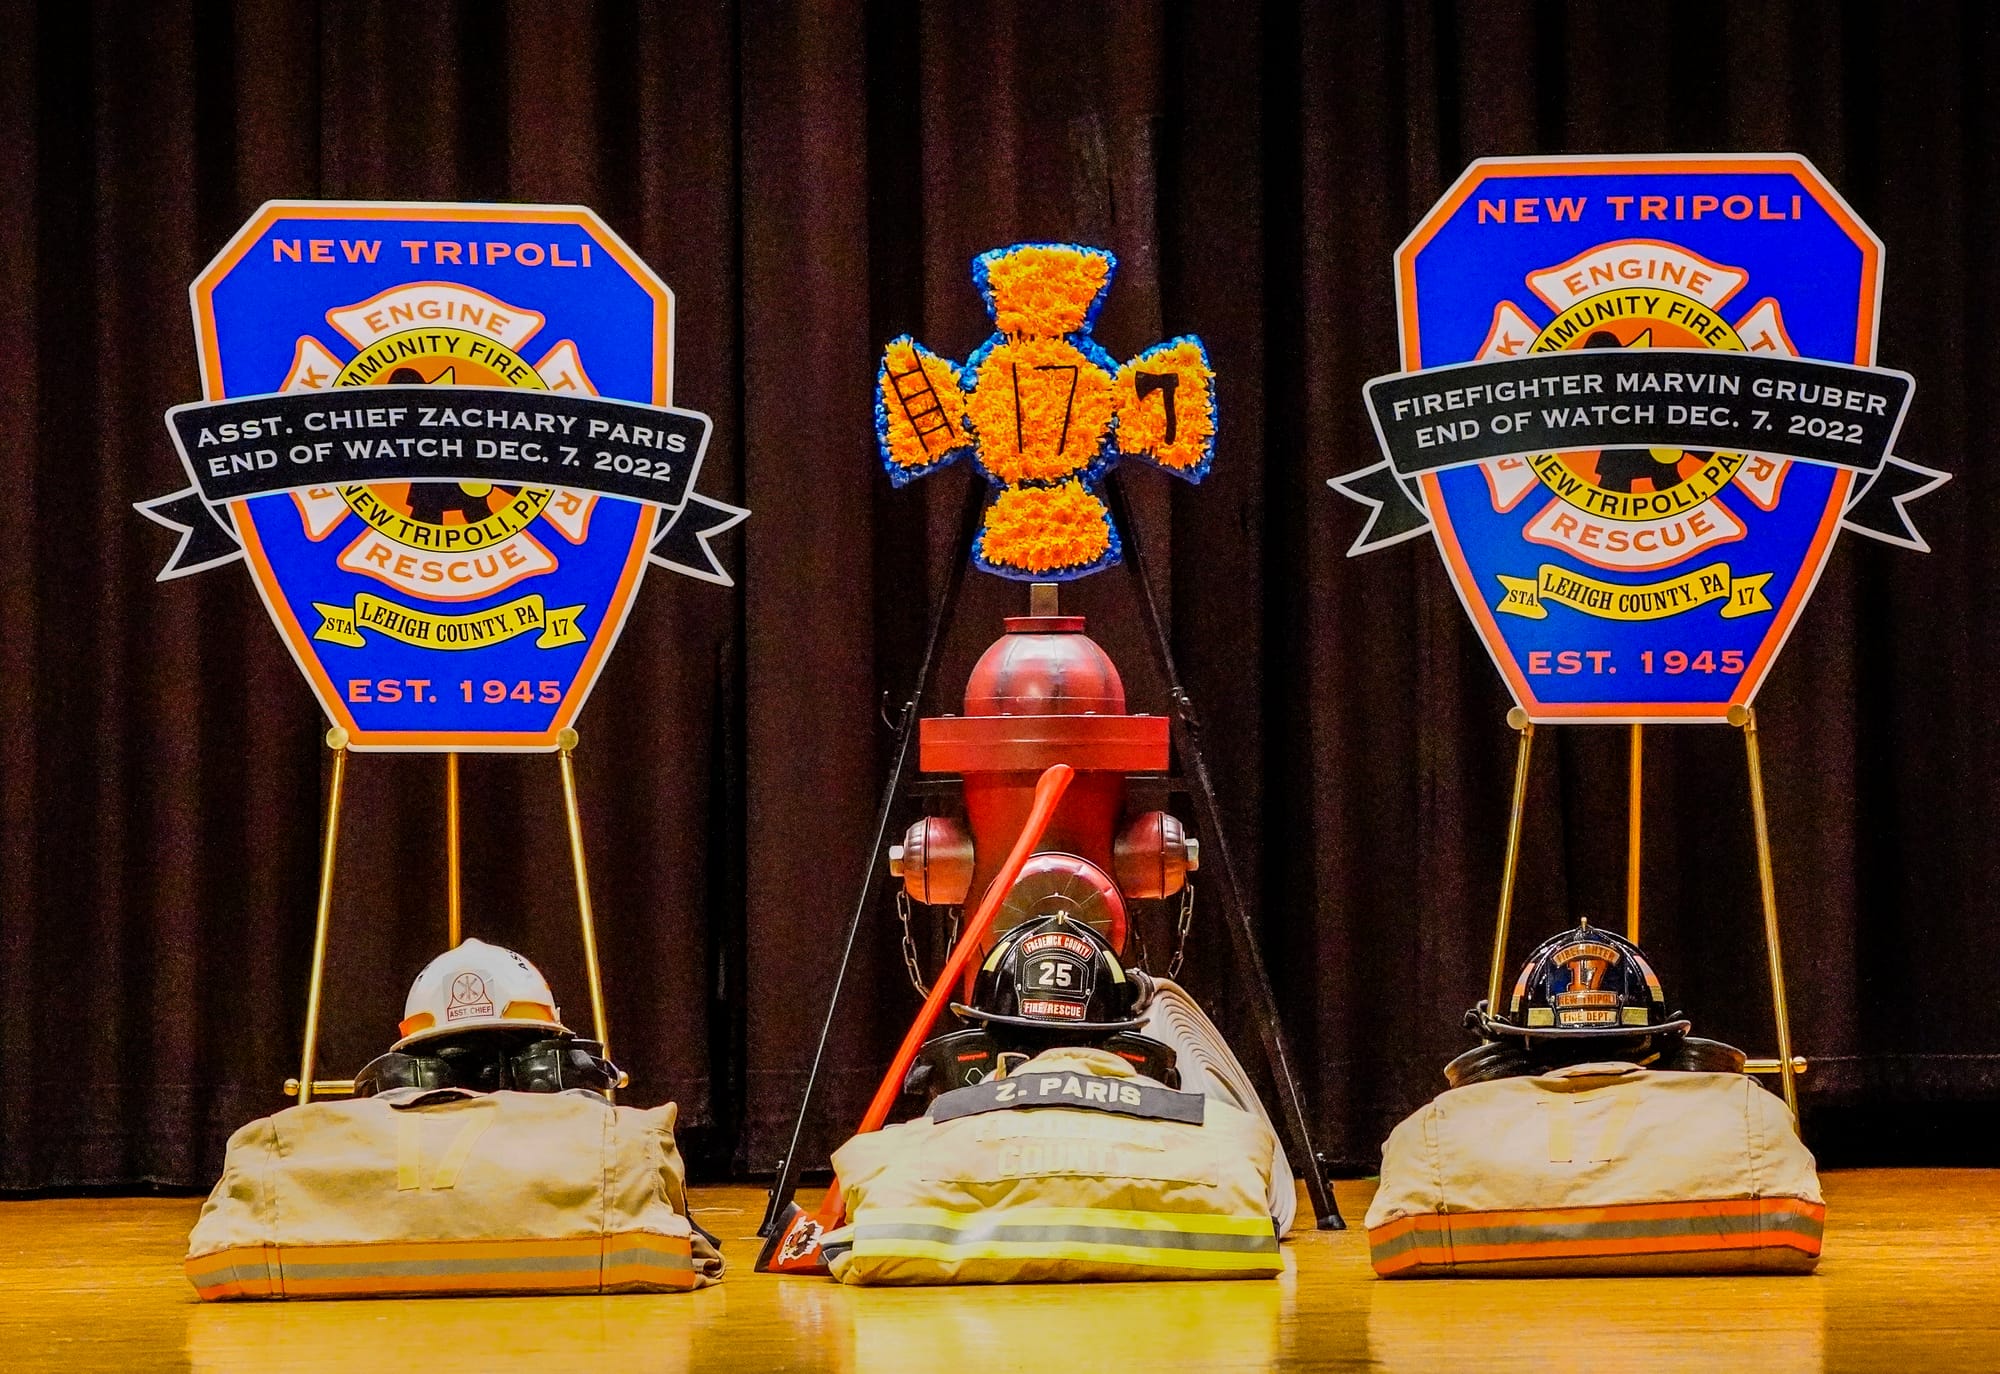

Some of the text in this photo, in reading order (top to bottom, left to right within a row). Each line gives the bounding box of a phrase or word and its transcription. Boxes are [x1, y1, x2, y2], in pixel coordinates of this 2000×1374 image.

[1477, 194, 1802, 224] NEW TRIPOLI
[272, 239, 593, 268] NEW TRIPOLI
[1563, 258, 1712, 296] ENGINE
[363, 299, 510, 336] ENGINE
[1666, 301, 1726, 347] FIRE
[469, 341, 528, 385] FIRE
[1012, 362, 1078, 456] 17
[1392, 373, 1888, 421] FIREFIGHTER MARVIN GRUBER
[197, 407, 687, 453] ASST. CHIEF ZACHARY PARIS
[1415, 420, 1481, 449] END
[1490, 411, 1532, 434] OF
[1540, 405, 1655, 429] WATCH
[1667, 405, 1740, 428] DEC.
[1787, 415, 1864, 444] 2022
[207, 449, 278, 478] END
[289, 442, 332, 465] OF
[342, 438, 464, 460] WATCH
[475, 440, 549, 463] DEC.
[594, 451, 671, 482] 2022
[1584, 484, 1709, 517] TRIPOLI,
[1703, 452, 1742, 486] PA.
[398, 516, 521, 549] TRIPOLI,
[513, 486, 549, 520] PA.
[1550, 510, 1716, 553] RESCUE
[365, 542, 528, 583] RESCUE
[1508, 573, 1756, 614] STA. LEHIGH COUNTY, PA 17
[326, 602, 570, 643] STA. LEHIGH COUNTY, PA 17
[1528, 650, 1746, 675] EST. 1945
[348, 679, 563, 704] EST. 1945
[1025, 935, 1091, 959] FREDERICK COUNTY
[1038, 962, 1073, 987] 25
[1567, 960, 1609, 991] 17
[450, 1005, 492, 1018] ASST CHIEF
[1558, 994, 1616, 1006] NEW TRIPOLI
[1587, 1012, 1613, 1022] DEPT.
[1039, 1076, 1142, 1107] PARIS
